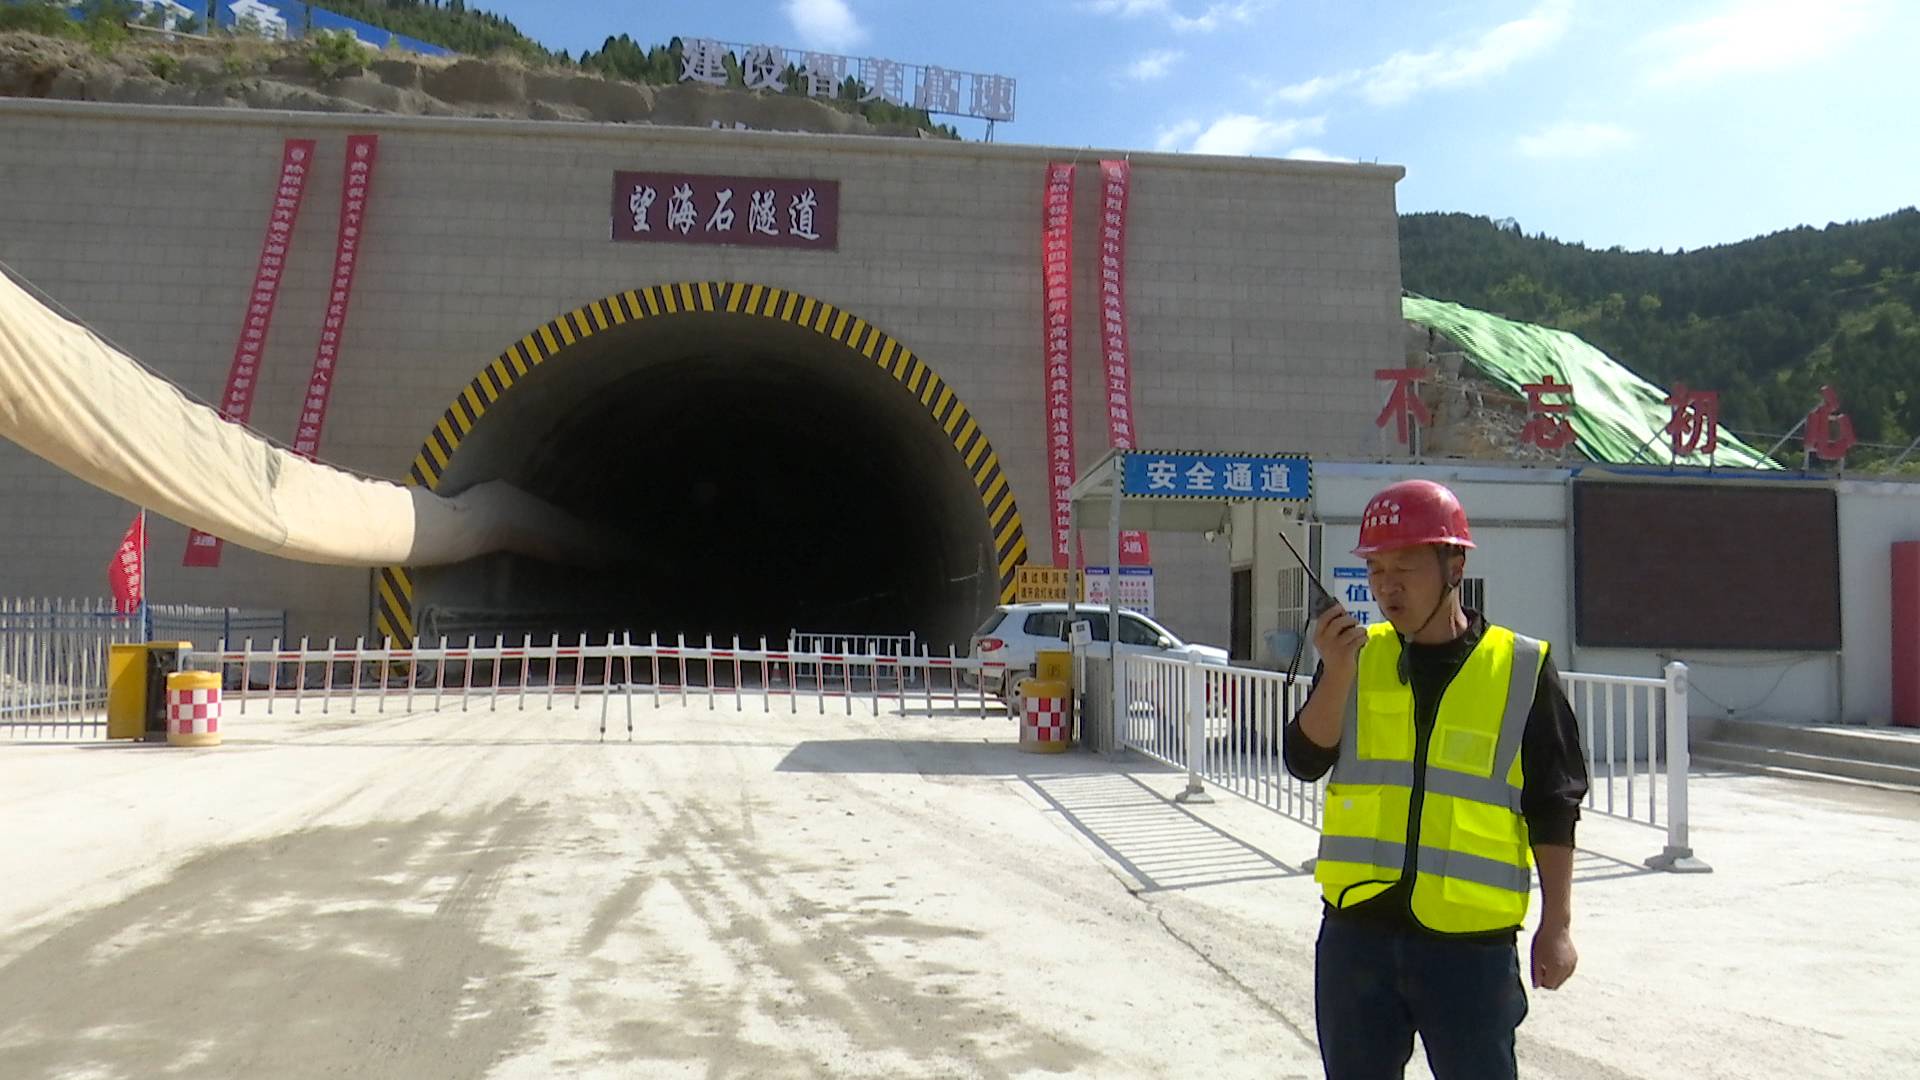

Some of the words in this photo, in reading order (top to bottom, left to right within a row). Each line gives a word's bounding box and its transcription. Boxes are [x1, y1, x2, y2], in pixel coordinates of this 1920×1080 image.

[678, 38, 1013, 118] 建设智美高速
[629, 183, 820, 240] 望海石隧道
[1374, 368, 1857, 461] 不忘初心
[1146, 460, 1291, 493] 安全通道
[1345, 583, 1377, 602] 值
